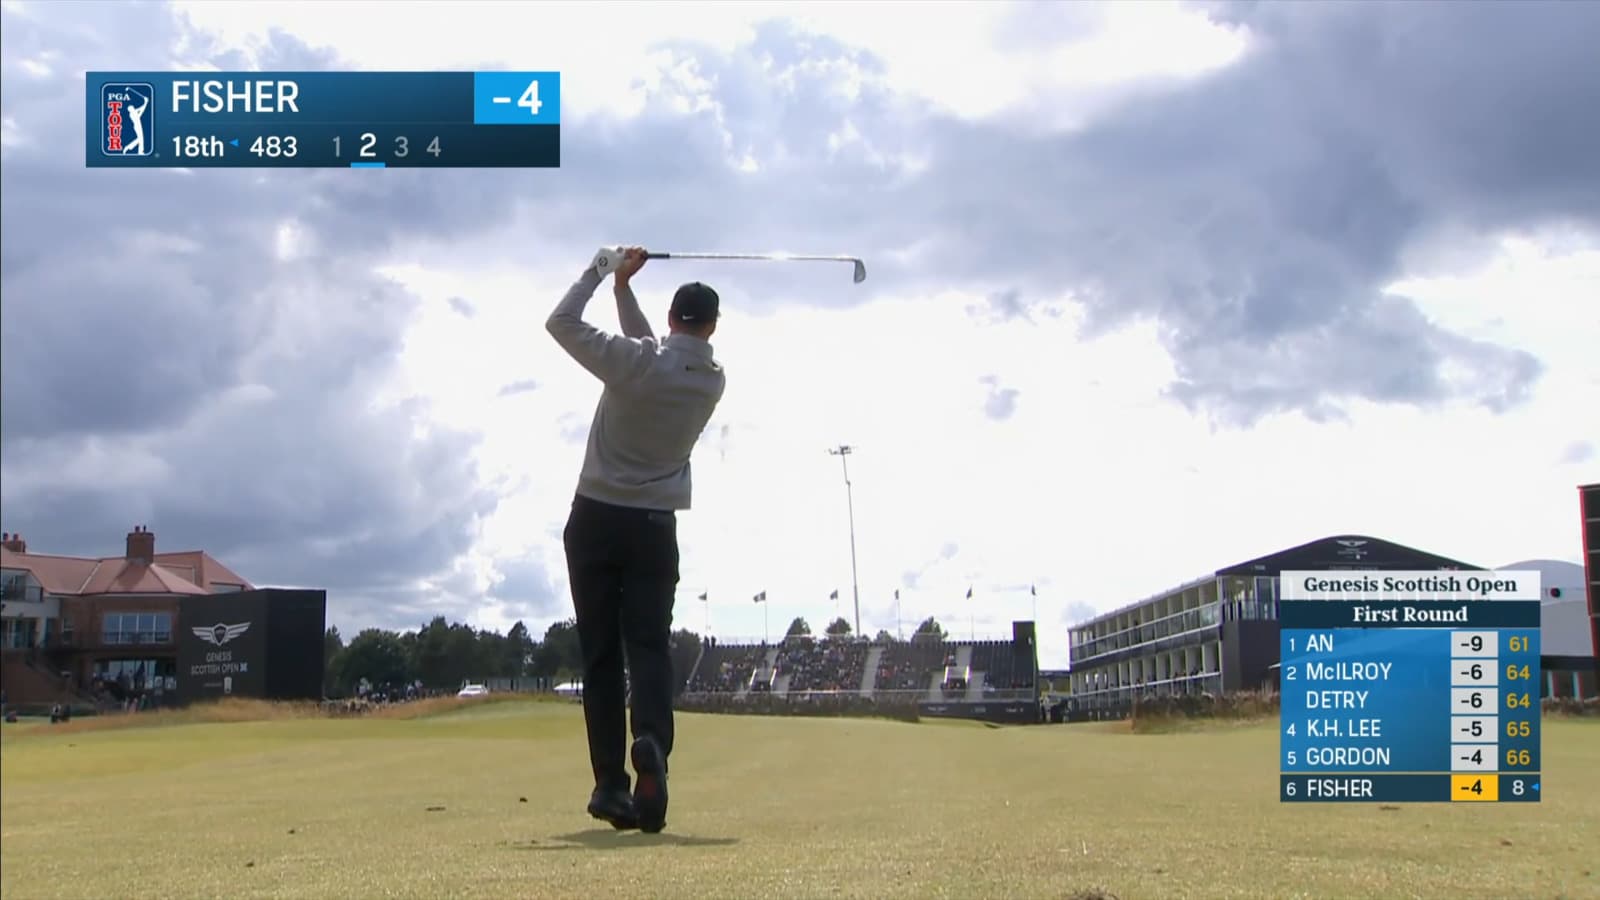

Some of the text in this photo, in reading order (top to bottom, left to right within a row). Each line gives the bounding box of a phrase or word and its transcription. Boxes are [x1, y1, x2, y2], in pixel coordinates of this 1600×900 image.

[206, 651, 232, 663] GENESIS
[191, 663, 240, 675] SCOTTISH OPEN
